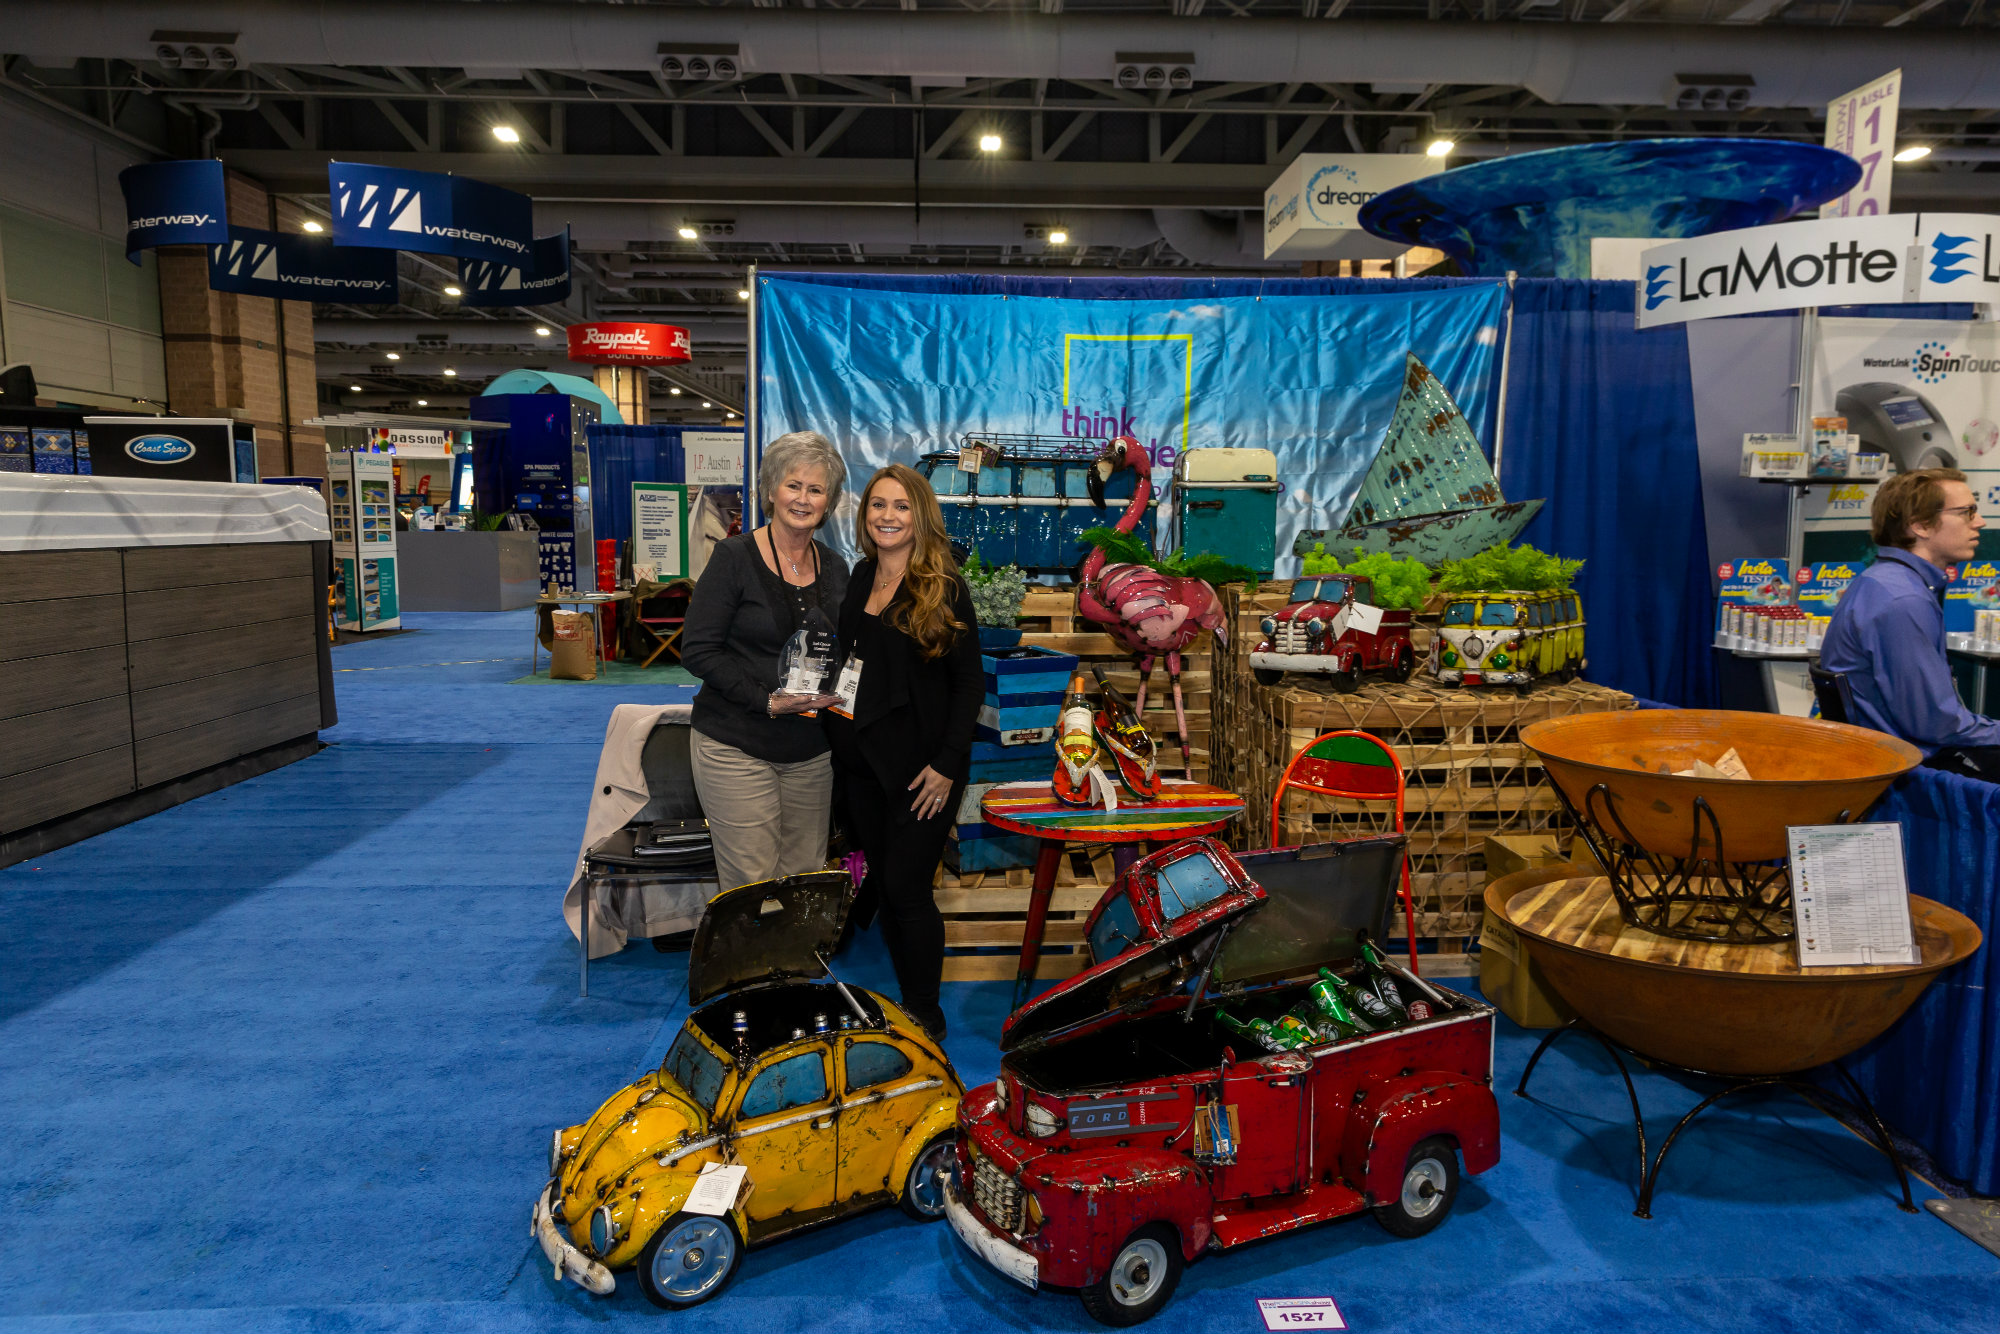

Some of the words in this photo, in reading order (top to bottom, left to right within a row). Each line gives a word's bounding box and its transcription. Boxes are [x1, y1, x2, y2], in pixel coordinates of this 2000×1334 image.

[1860, 83, 1894, 108] AISLE
[424, 225, 526, 253] waterway
[1983, 234, 2000, 283] L
[1680, 240, 1897, 303] LaMotte
[280, 274, 386, 290] waterway
[582, 328, 650, 350] Raypak
[1863, 357, 1910, 369] WaterLink
[1061, 406, 1137, 438] think
[390, 434, 444, 445] passion
[133, 441, 162, 454] Coast
[163, 442, 188, 455] Spas
[707, 455, 731, 471] Austin
[1832, 500, 1866, 510] TEST
[1738, 560, 1777, 577] Insta-
[1742, 575, 1771, 584] TEST
[1072, 1111, 1127, 1125] FORD
[1279, 1312, 1324, 1322] 1527
